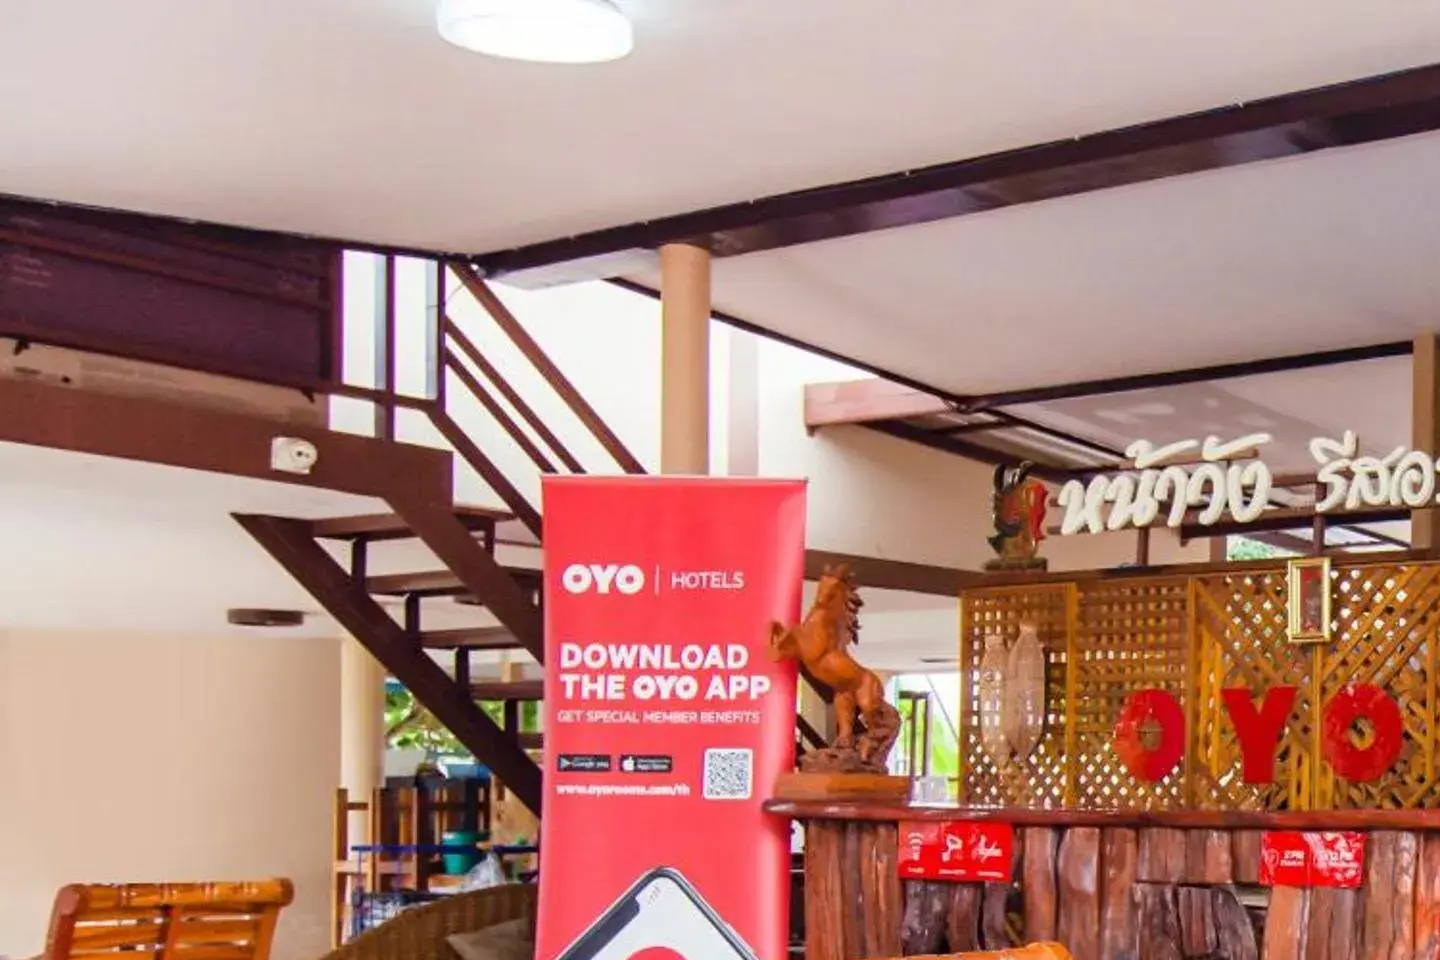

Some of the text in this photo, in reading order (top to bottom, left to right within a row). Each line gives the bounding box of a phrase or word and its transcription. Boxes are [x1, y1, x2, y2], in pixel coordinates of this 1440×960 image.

[1058, 434, 1273, 535] หน้าวัง
[562, 563, 744, 595] OYO HOTELS
[560, 643, 749, 670] DOWNLOAD
[560, 674, 771, 700] THE OYO APP
[557, 710, 760, 724] GET SPECIAL MEMBER BENEFITS
[1114, 682, 1402, 785] OYO
